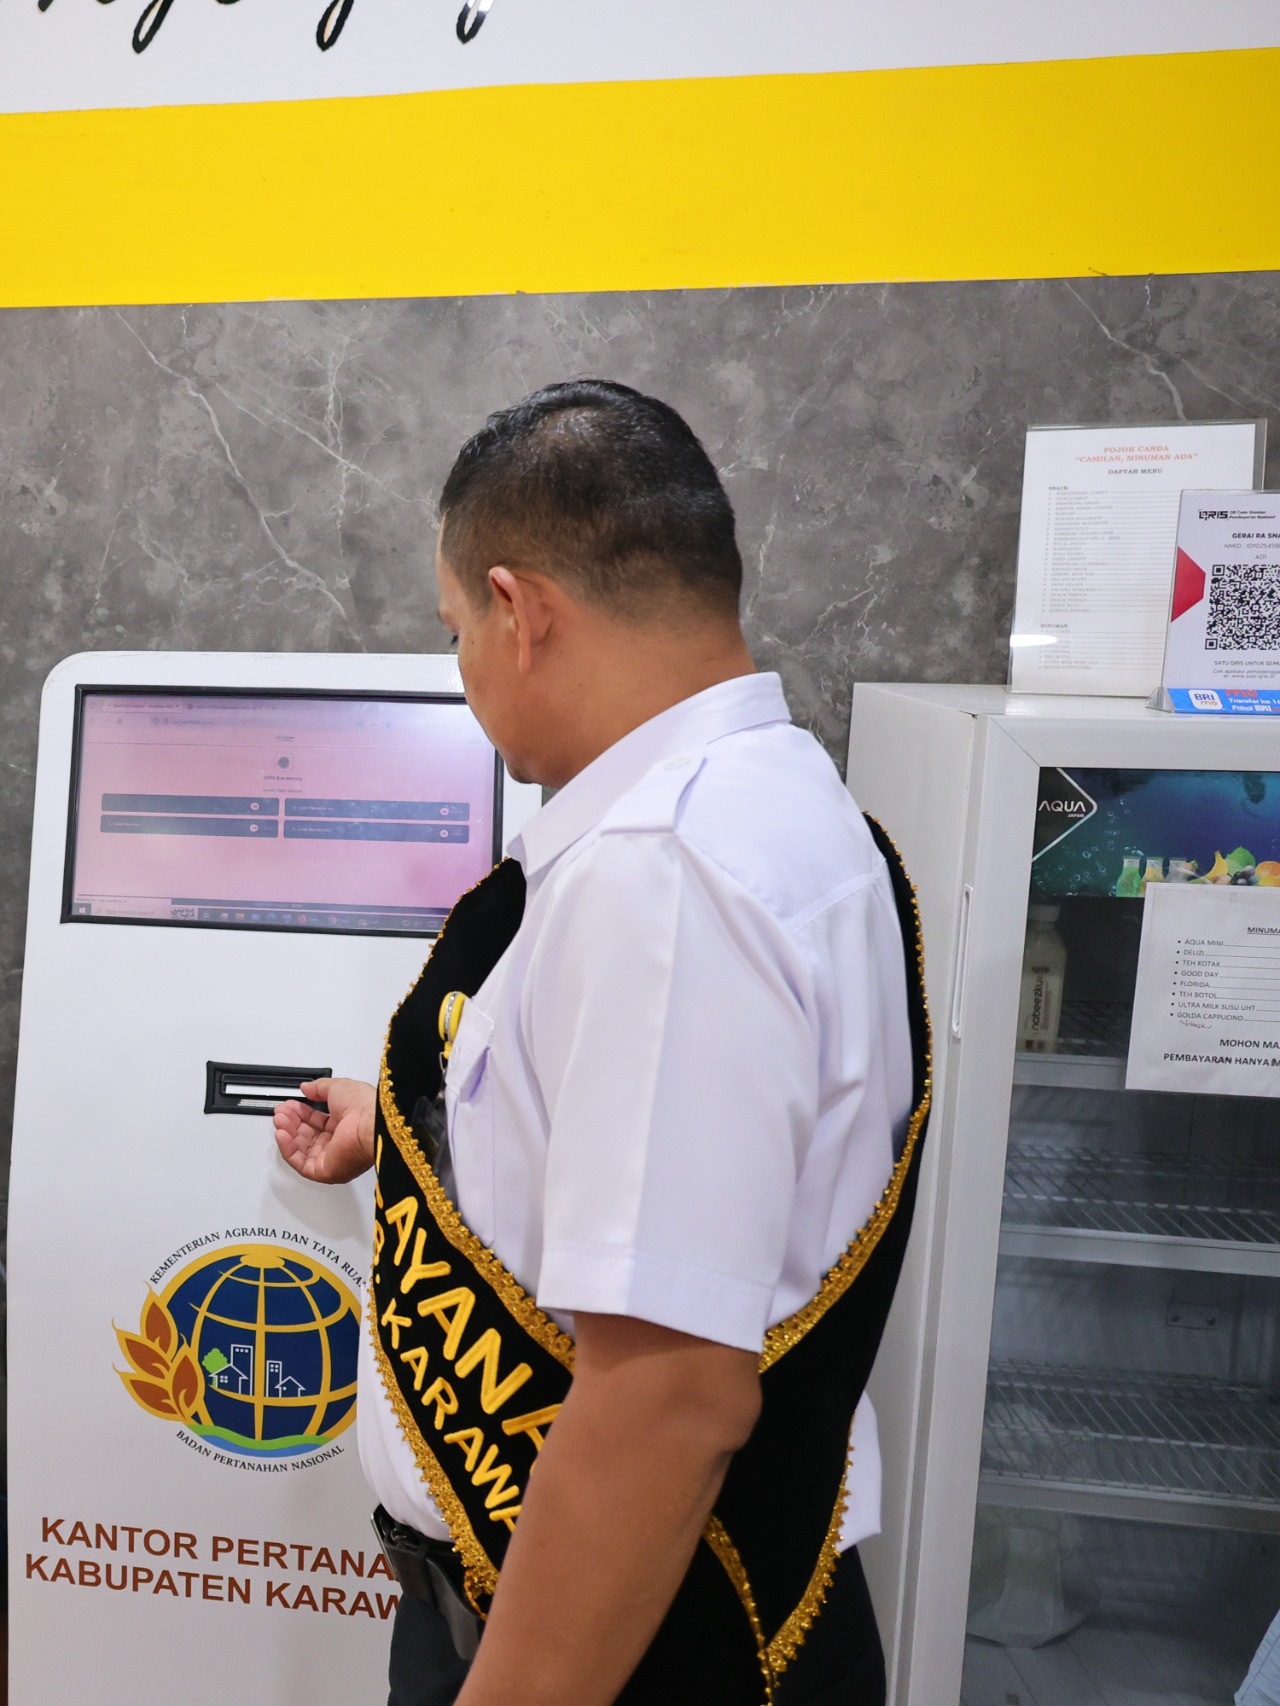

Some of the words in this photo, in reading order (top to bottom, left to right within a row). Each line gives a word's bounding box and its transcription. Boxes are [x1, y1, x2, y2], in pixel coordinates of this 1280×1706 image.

[1194, 693, 1215, 701] BRI
[1038, 800, 1086, 812] AQUA
[1219, 1038, 1260, 1048] MOHON
[1163, 1053, 1232, 1064] PEMBAYARAN
[1234, 1057, 1270, 1067] HANYA
[150, 1232, 221, 1285] KEMENTERIAN
[224, 1227, 278, 1240] AGRARIA
[282, 1230, 310, 1246] DAN
[312, 1240, 341, 1265] TATA
[341, 1259, 367, 1288] RUA
[175, 1429, 211, 1458] BADAN
[213, 1452, 288, 1473] PERTANAHAN
[291, 1445, 345, 1471] NASIONAL
[42, 1516, 199, 1560] KANTOR
[211, 1535, 396, 1582] PERTANA
[25, 1553, 252, 1605] KABUPATEN
[266, 1581, 399, 1621] KARAW
